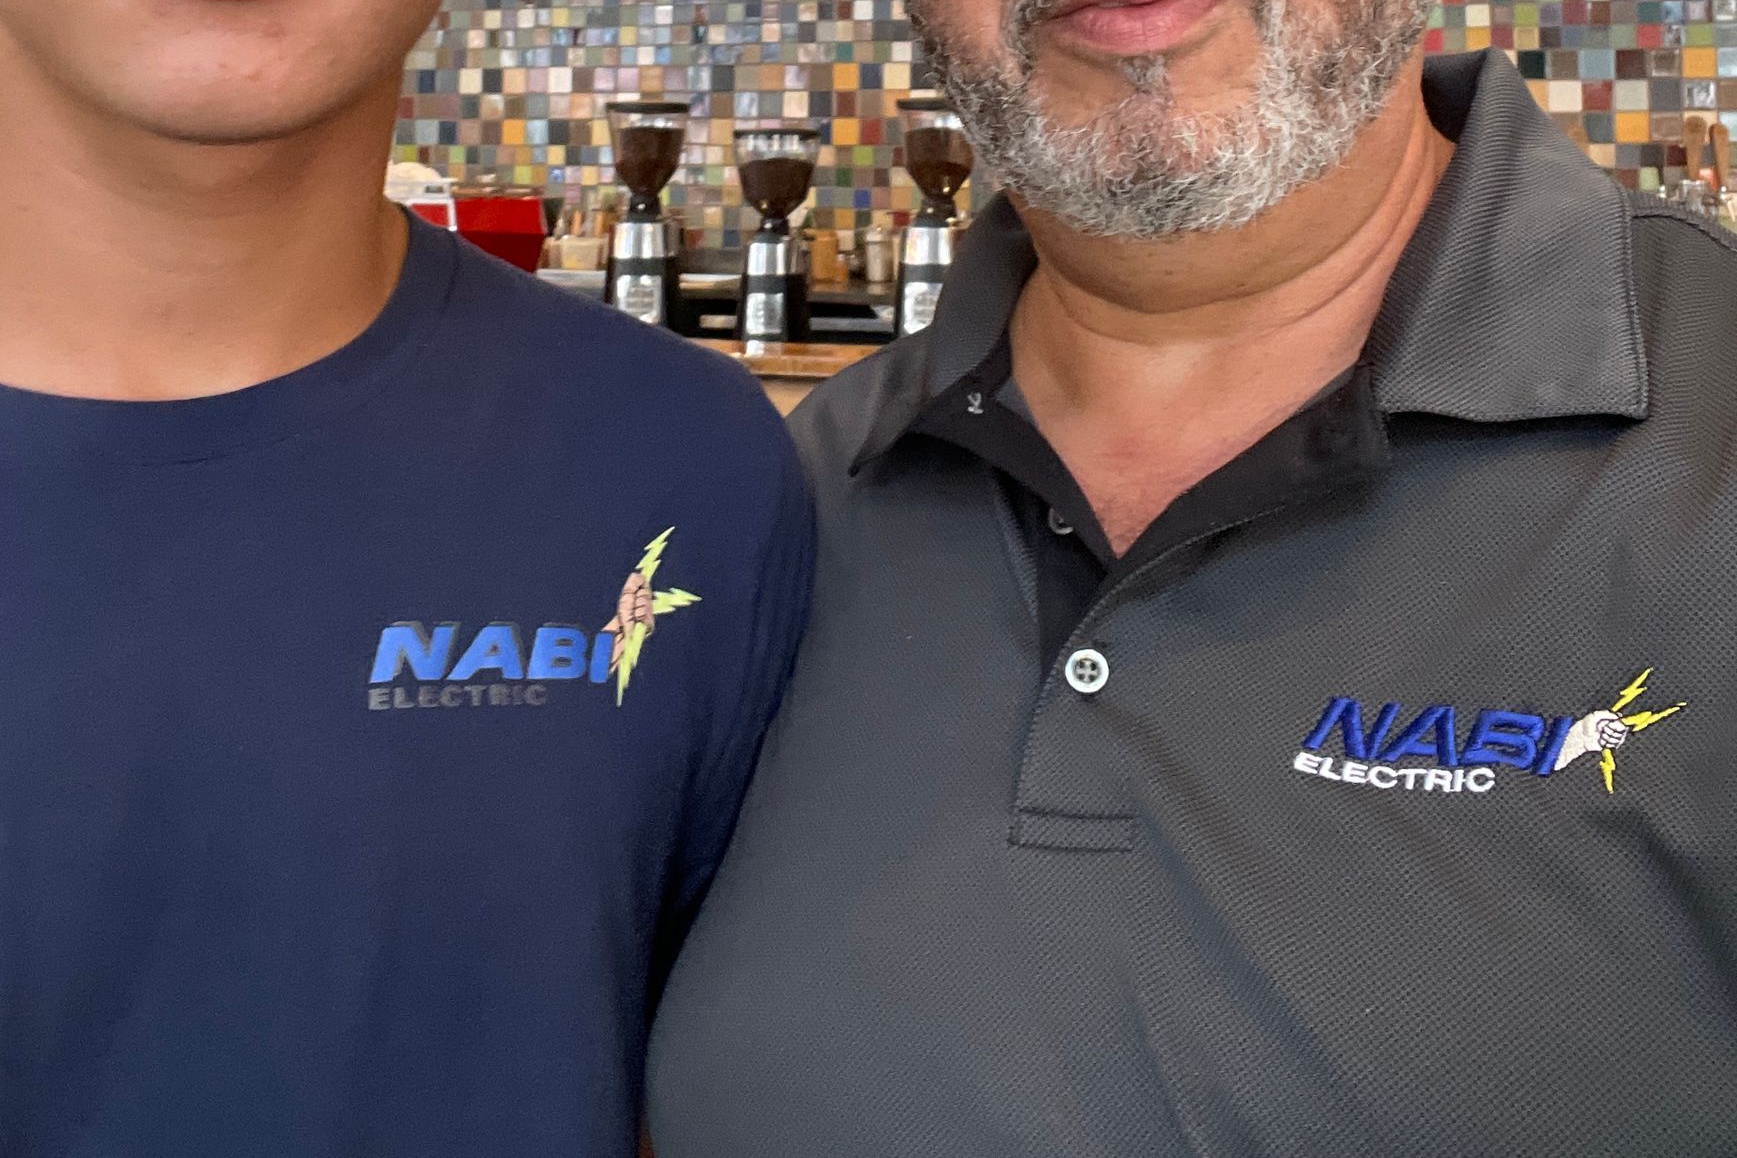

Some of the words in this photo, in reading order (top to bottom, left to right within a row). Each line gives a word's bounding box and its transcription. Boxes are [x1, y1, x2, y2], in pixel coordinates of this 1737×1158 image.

[369, 621, 616, 684] NABI
[367, 683, 548, 711] ELECTRIC
[1301, 696, 1575, 777] NABI
[1293, 752, 1497, 793] ELECTRIC
